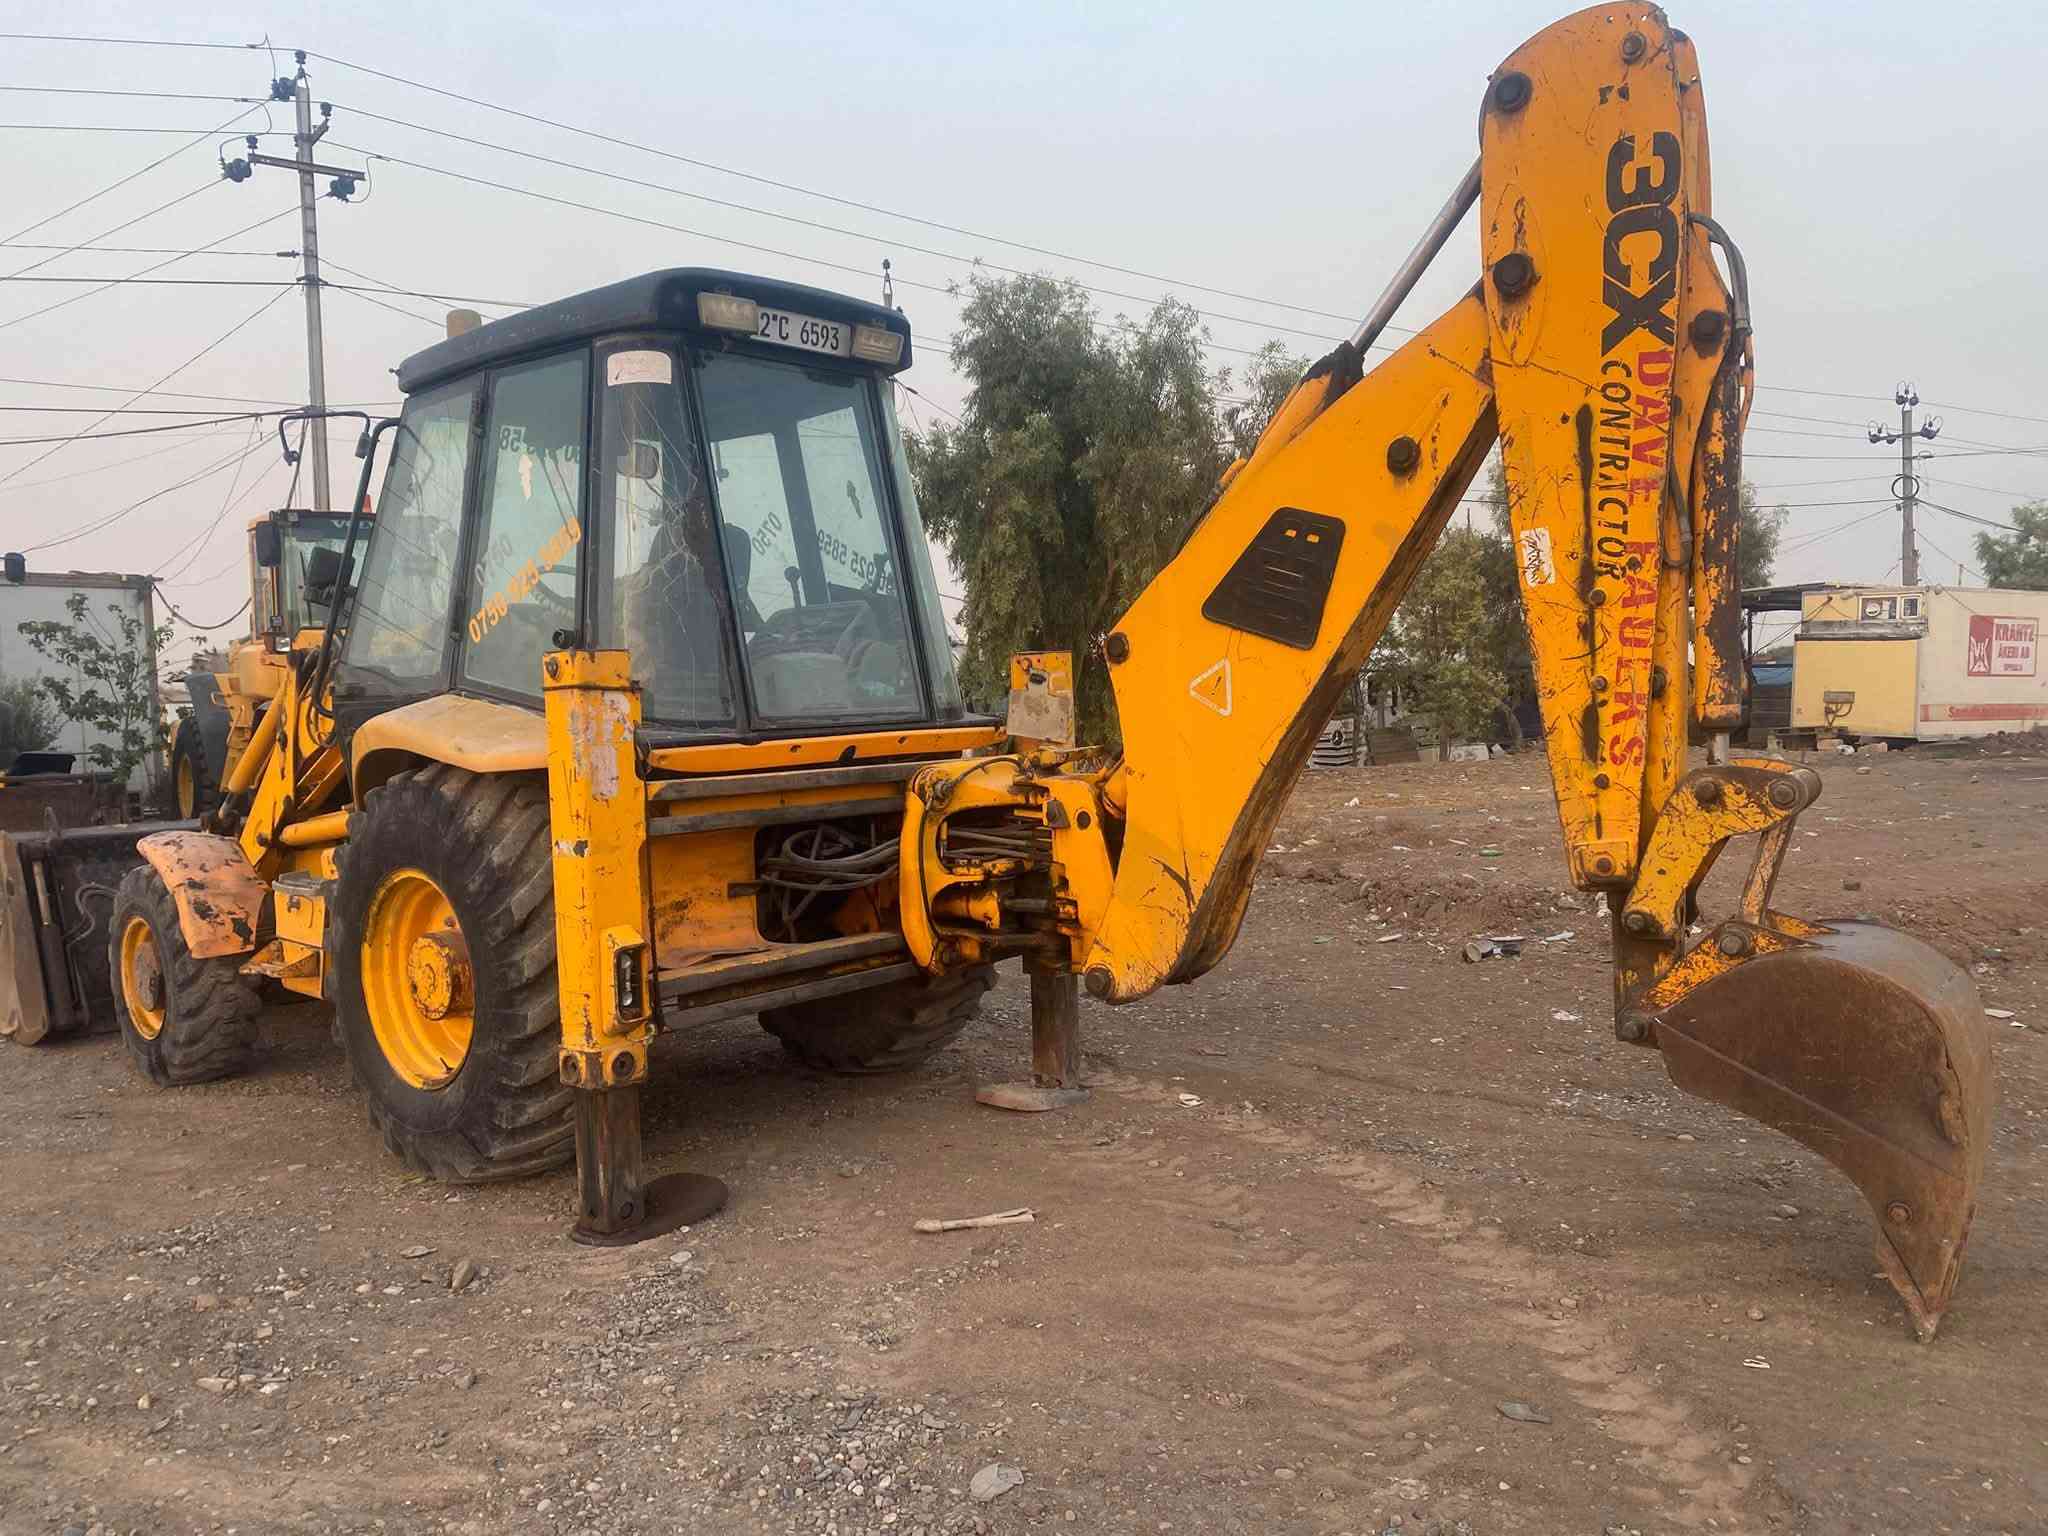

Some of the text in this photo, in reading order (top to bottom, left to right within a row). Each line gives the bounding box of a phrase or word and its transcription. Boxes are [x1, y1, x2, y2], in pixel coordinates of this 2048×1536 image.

[800, 319, 840, 351] 6593
[1601, 131, 1682, 357] 3CX
[1596, 360, 1633, 582] CONTRACTOR
[1629, 350, 1674, 507] DAVE
